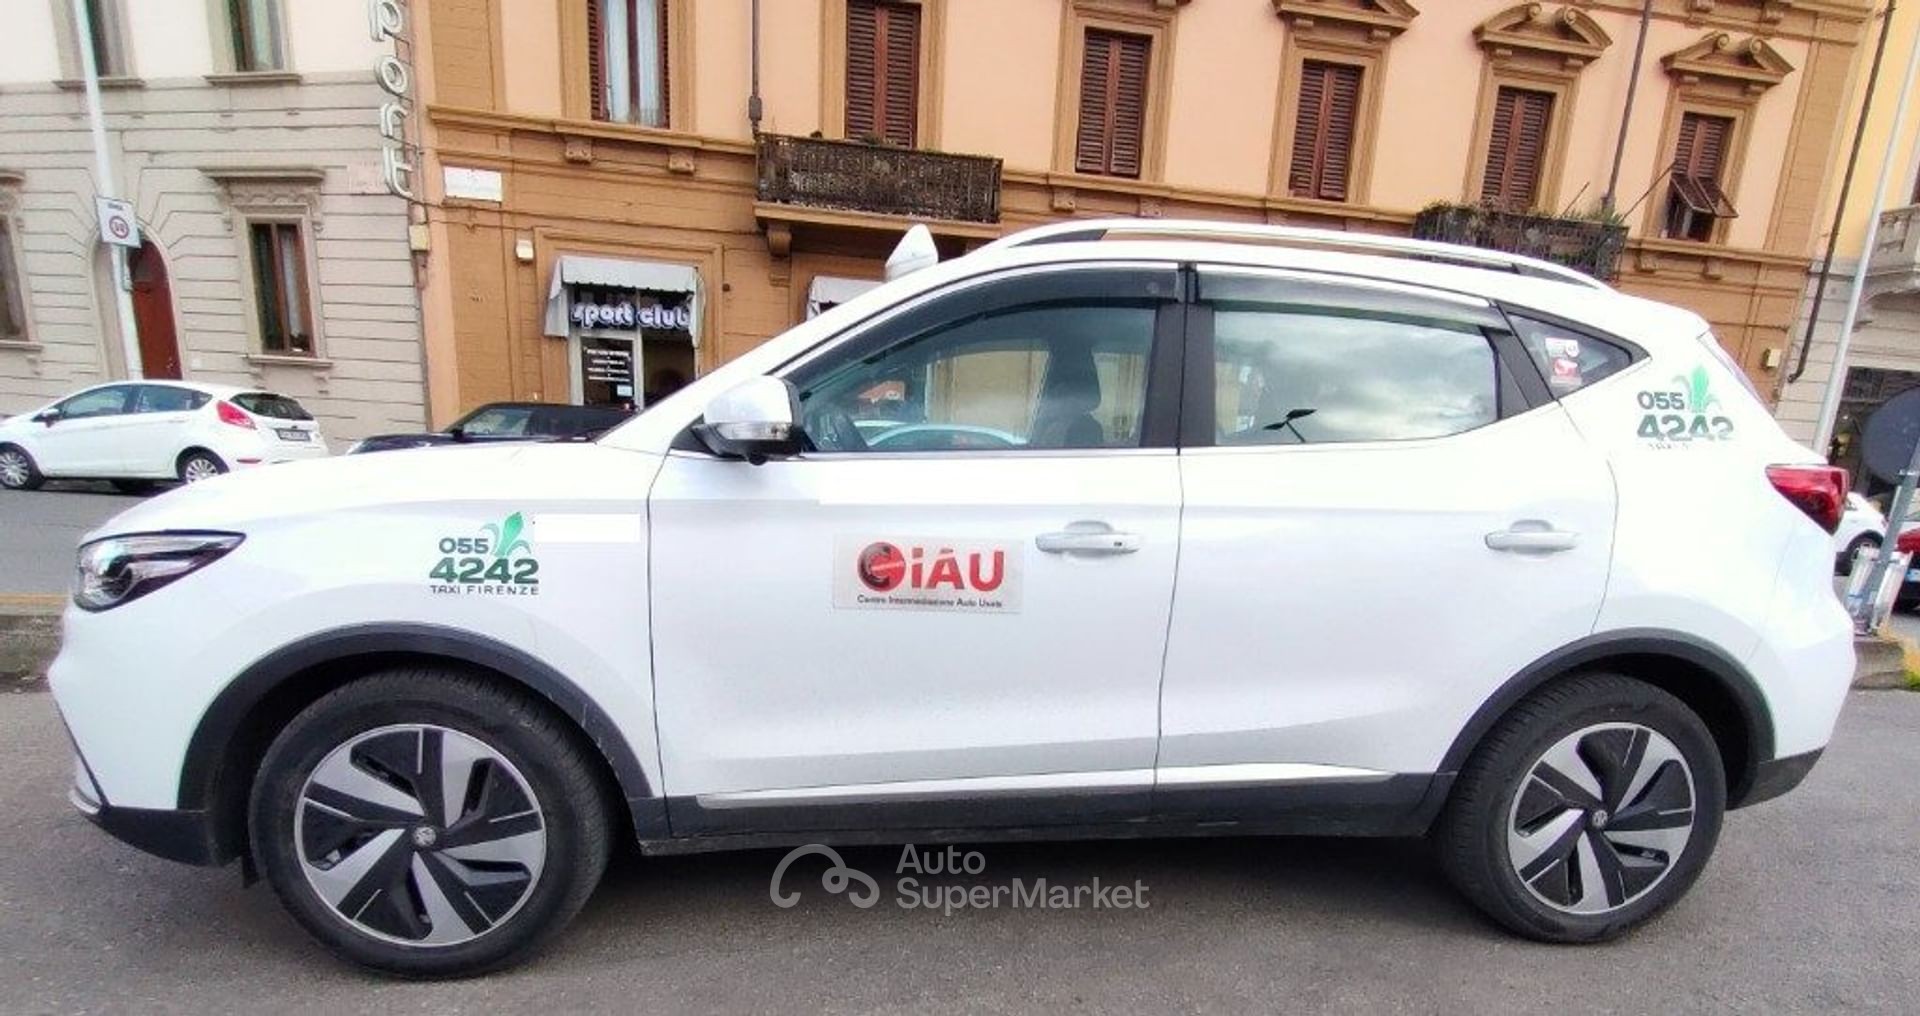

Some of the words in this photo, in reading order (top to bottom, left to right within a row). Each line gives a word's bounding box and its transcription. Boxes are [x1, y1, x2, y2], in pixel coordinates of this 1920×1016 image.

[571, 302, 634, 329] sport
[637, 304, 692, 329] club
[1637, 391, 1685, 410] 055
[1637, 414, 1734, 441] 4242
[438, 537, 489, 554] 055
[429, 557, 540, 584] 4242
[430, 585, 461, 594] TAXI
[467, 585, 540, 596] FIRENZE
